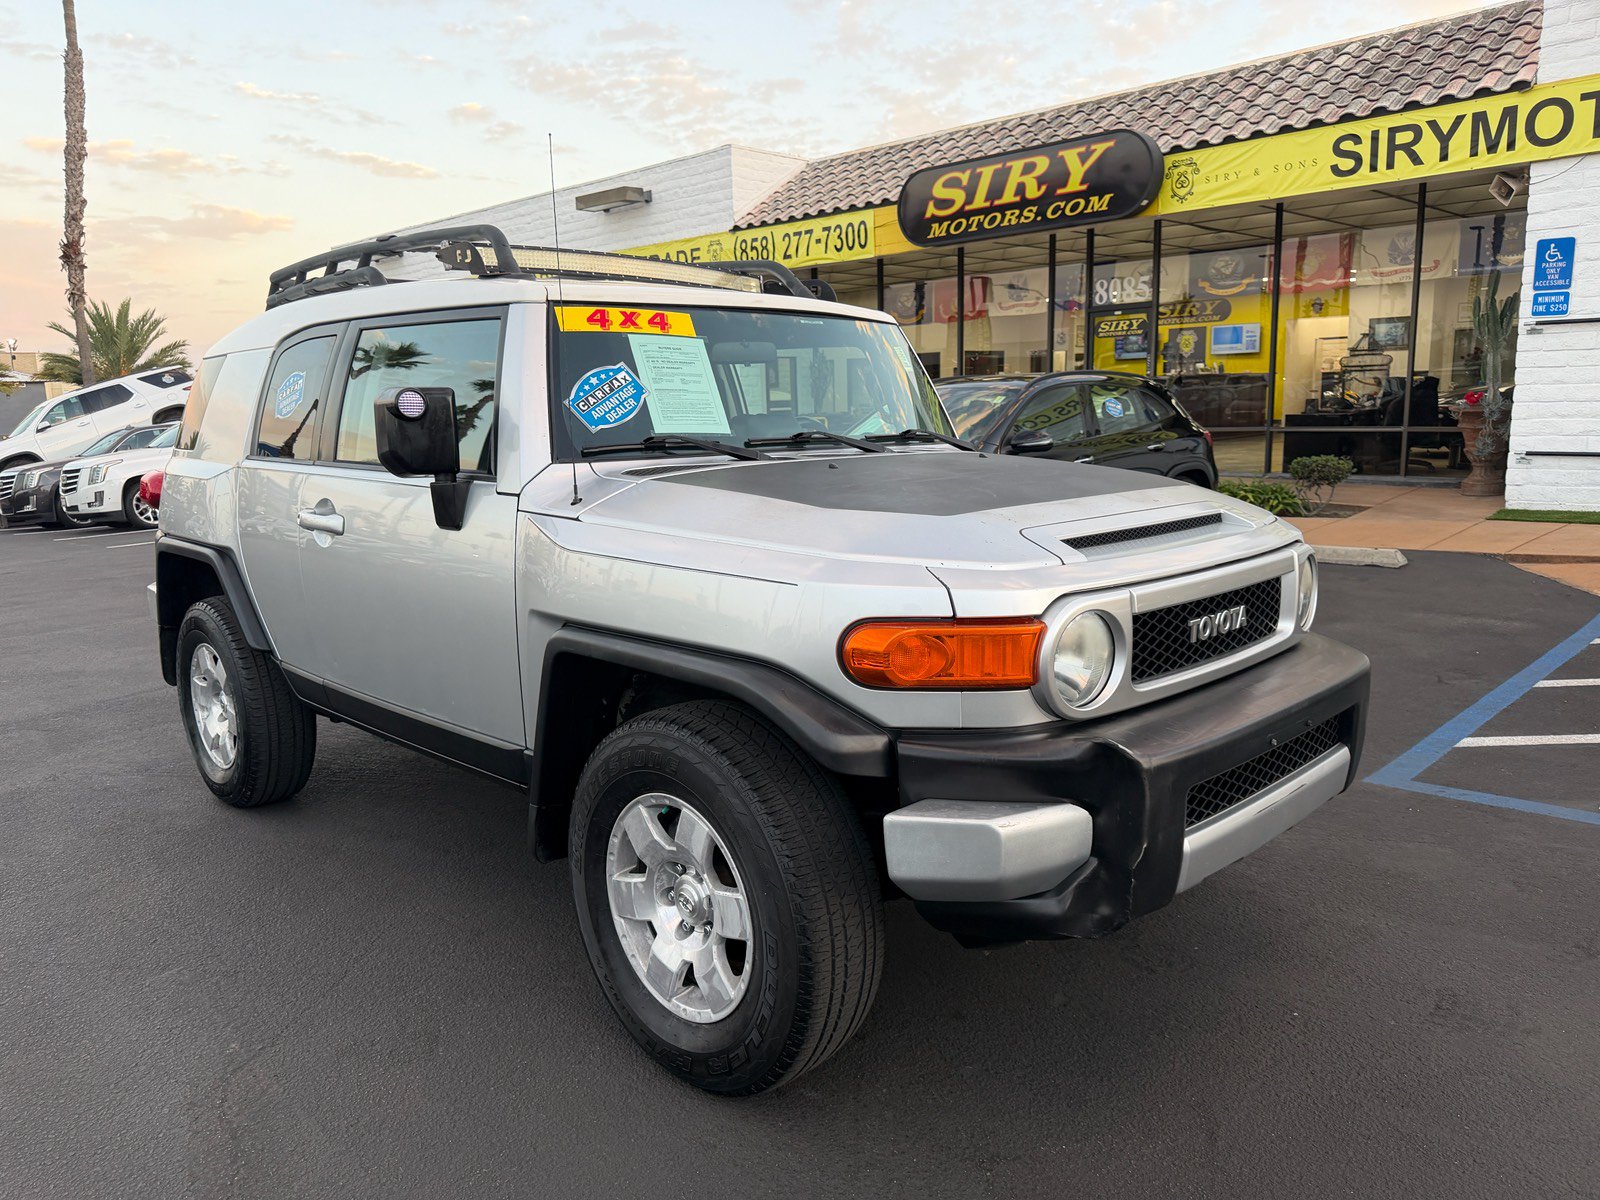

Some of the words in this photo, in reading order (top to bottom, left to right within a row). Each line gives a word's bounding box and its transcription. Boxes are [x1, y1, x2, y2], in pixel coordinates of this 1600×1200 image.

[924, 139, 1117, 220] SIRY
[1204, 169, 1241, 185] SIRY
[1253, 168, 1261, 177] &
[1273, 157, 1319, 174] SONS
[926, 193, 1114, 239] MOTORS.COM
[734, 230, 775, 261] (858)
[782, 220, 868, 260] 277-7300
[1095, 275, 1151, 305] 8085
[1097, 317, 1144, 333] SIRY
[1158, 300, 1220, 318] SIRY
[1533, 304, 1547, 312] FINE
[1550, 304, 1567, 312] $250
[578, 374, 630, 411] CARFAX
[591, 385, 637, 420] ADVANTAGE
[605, 397, 637, 423] DEALER
[1187, 605, 1248, 644] TOYOTA
[707, 930, 779, 1076] DUELER
